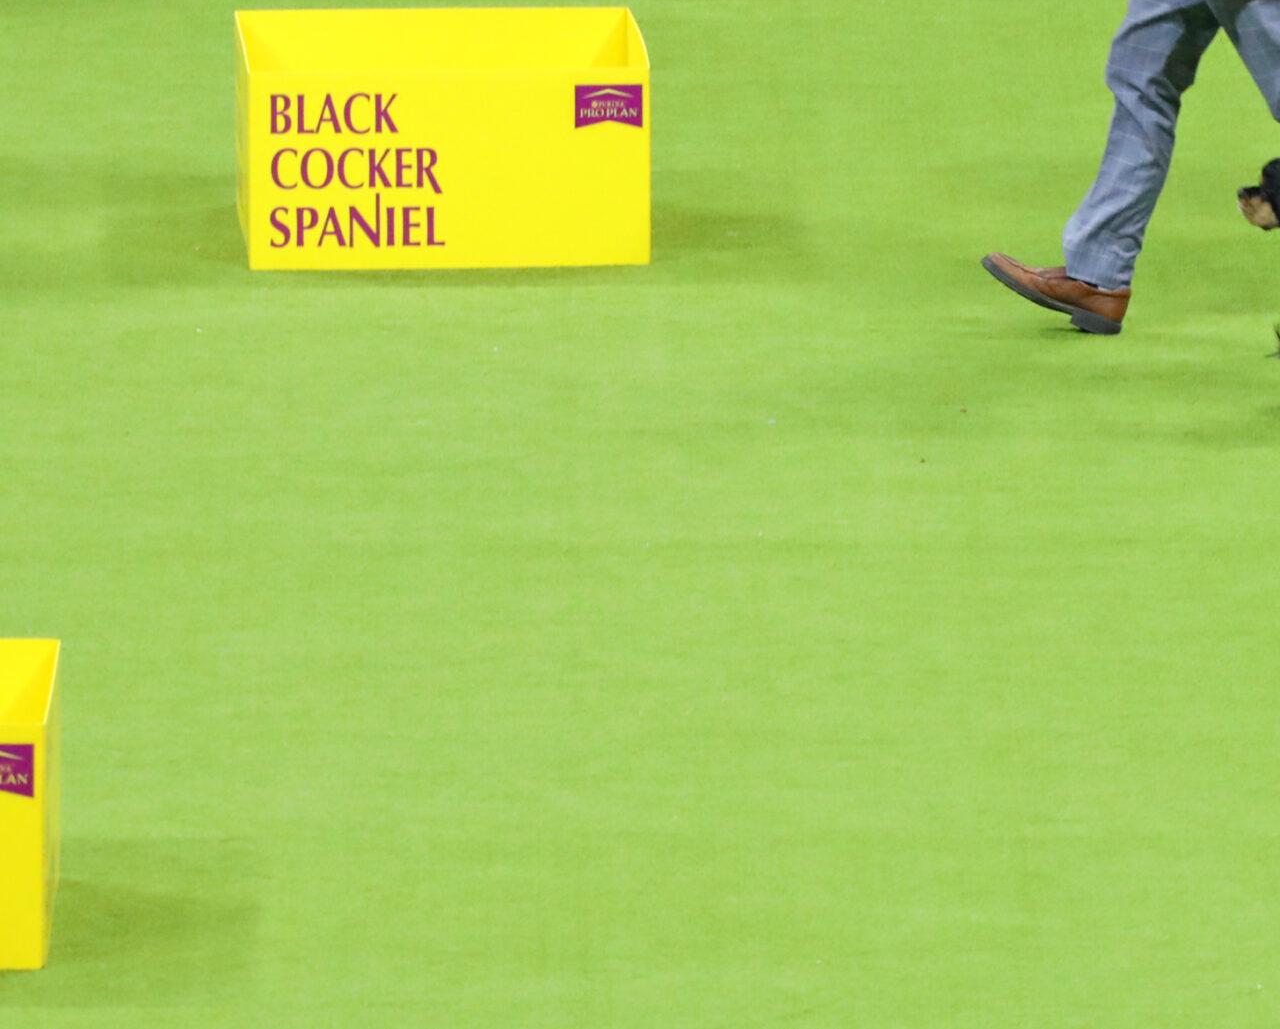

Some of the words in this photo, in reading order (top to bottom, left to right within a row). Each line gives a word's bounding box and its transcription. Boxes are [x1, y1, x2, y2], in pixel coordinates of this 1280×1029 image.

[270, 93, 399, 135] BLACK
[580, 107, 605, 118] PRO
[606, 107, 638, 118] PLAN
[270, 147, 443, 195] COCKER
[269, 193, 446, 248] SPANIEL
